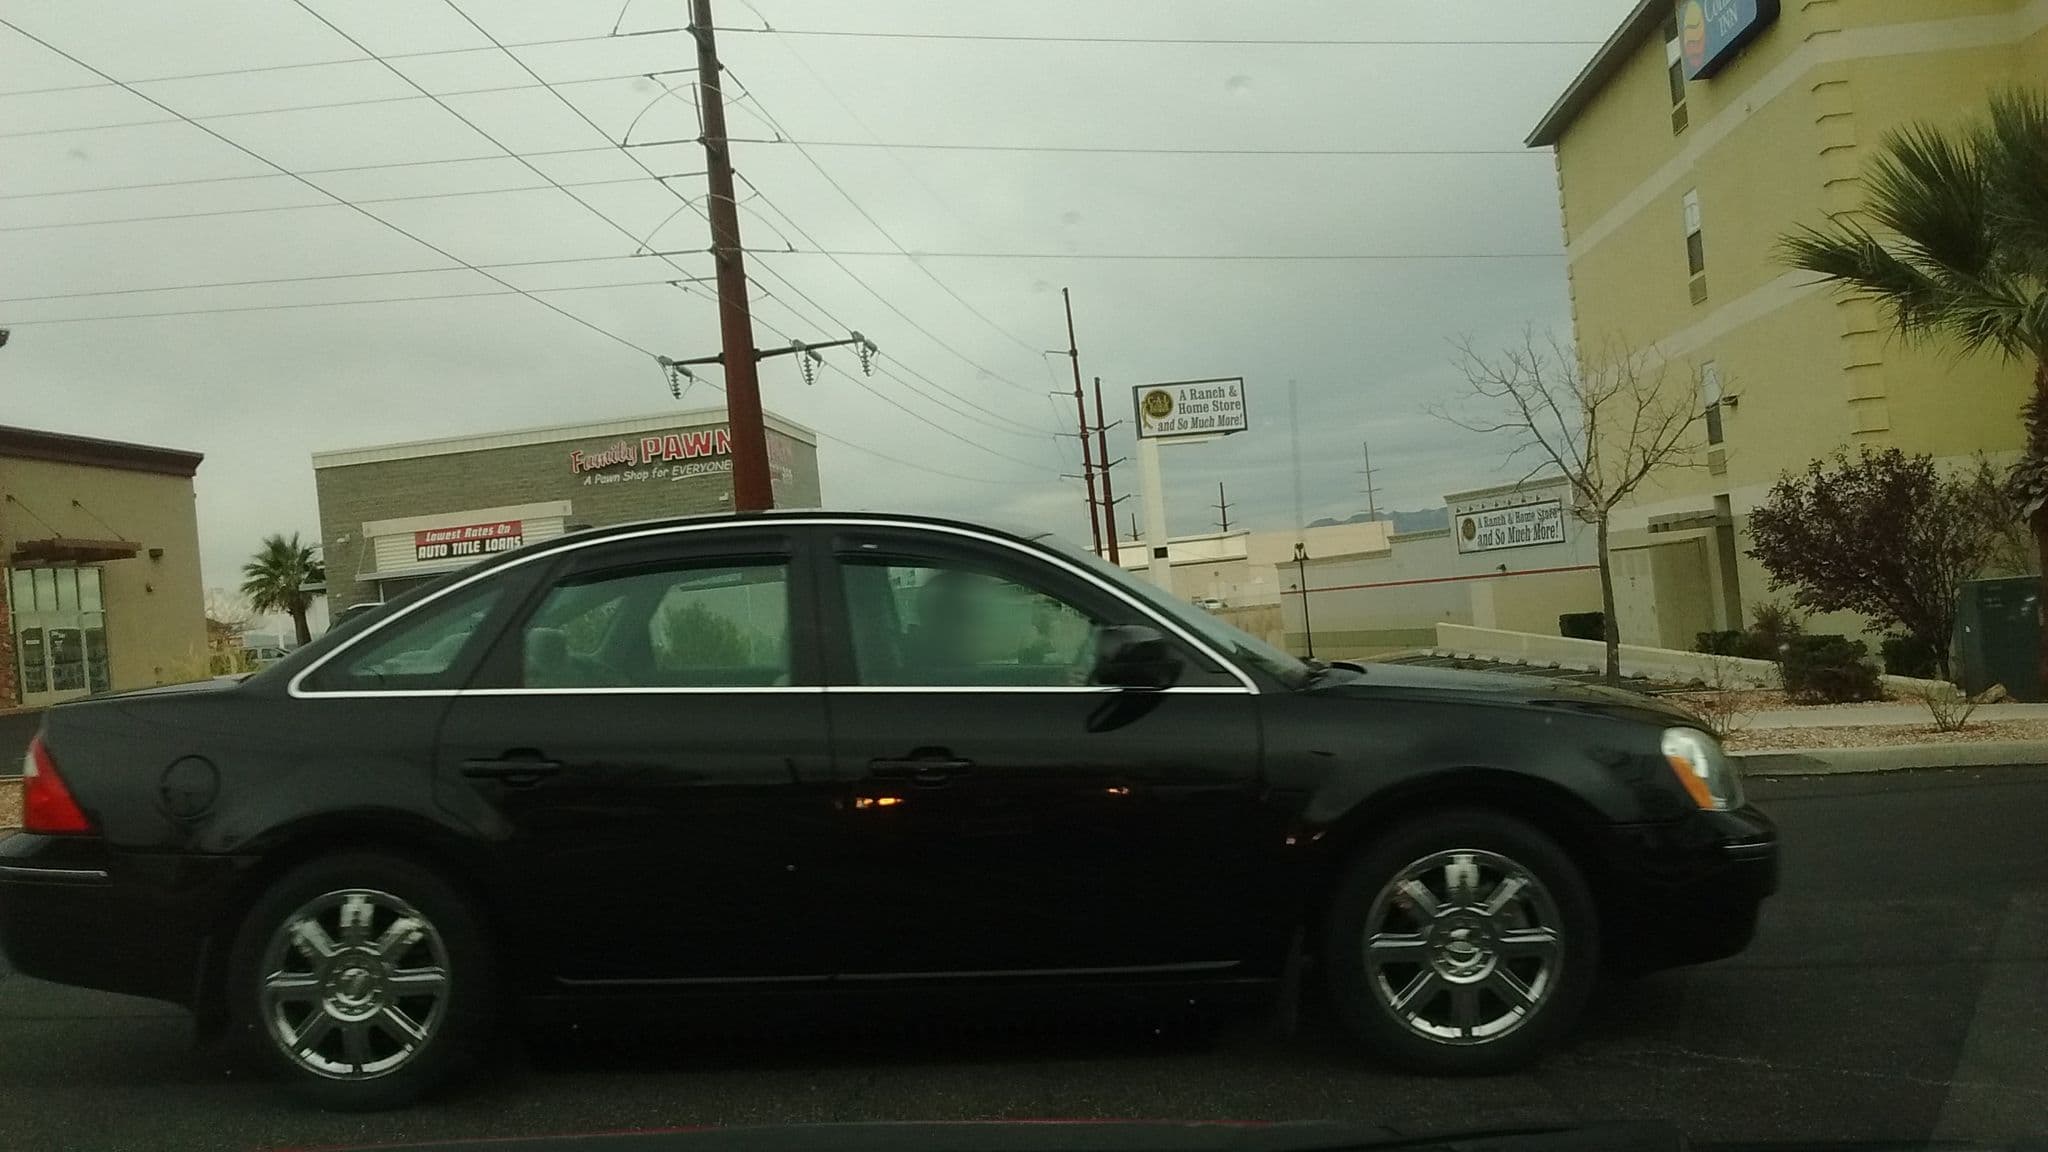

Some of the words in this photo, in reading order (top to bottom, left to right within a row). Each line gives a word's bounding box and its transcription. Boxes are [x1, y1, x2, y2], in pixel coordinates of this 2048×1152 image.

[1179, 389, 1186, 401] A
[1190, 386, 1225, 401] Ranch
[1229, 385, 1238, 397] &
[1178, 401, 1209, 414] Home
[1212, 400, 1241, 412] Store
[1157, 418, 1175, 431] and
[1177, 418, 1188, 430] So
[1191, 415, 1215, 429] Much
[1218, 413, 1243, 426] More!
[570, 440, 638, 474] Family
[641, 427, 732, 464] PAWN
[584, 475, 592, 486] A
[595, 473, 620, 484] Pawn
[623, 470, 649, 482] Shop
[652, 467, 669, 478] for
[425, 530, 461, 542] Lowest
[464, 526, 494, 538] Rates
[498, 524, 511, 534] On
[1478, 529, 1493, 547] and
[1495, 527, 1505, 545] So
[1507, 524, 1531, 544] Much
[1533, 520, 1559, 541] More!
[418, 544, 448, 559] AUTO
[452, 540, 480, 555] TITLE
[485, 536, 521, 552] LOANS
